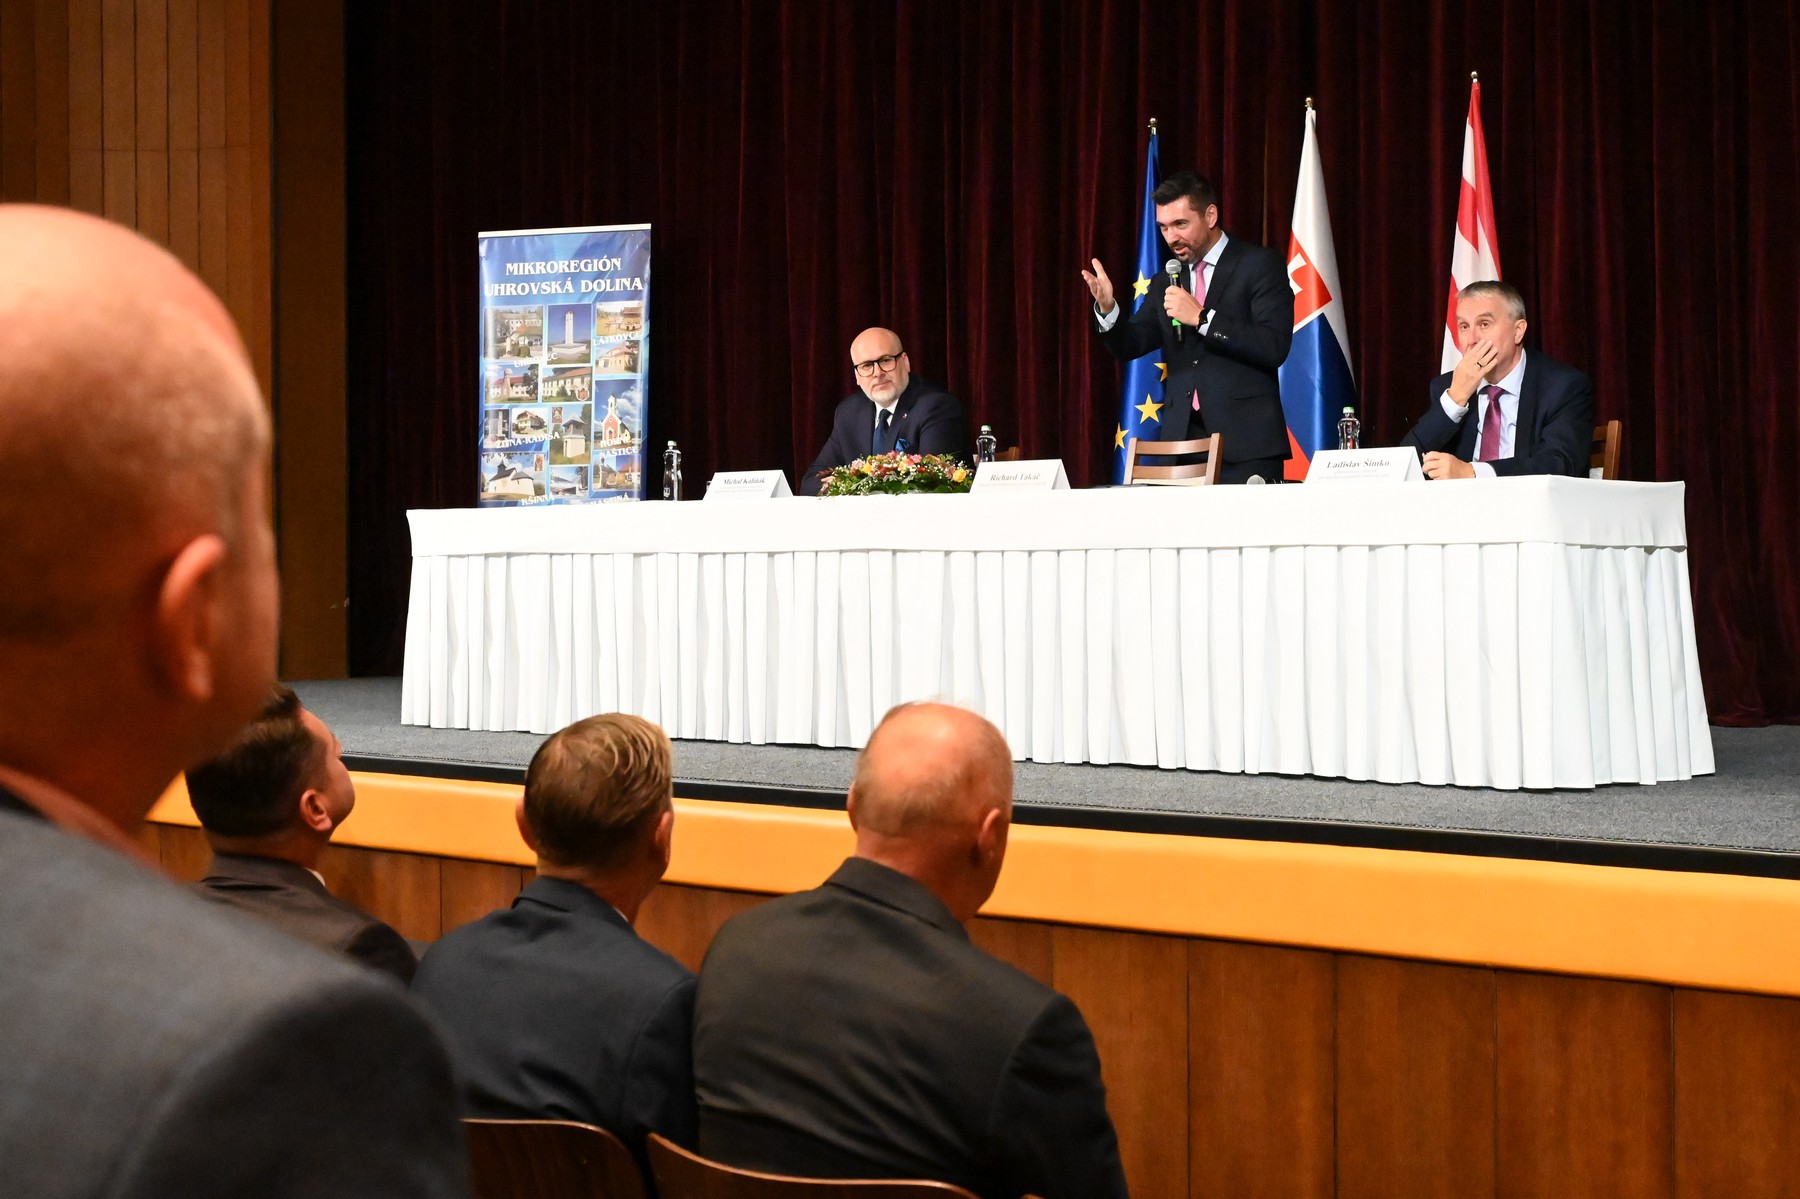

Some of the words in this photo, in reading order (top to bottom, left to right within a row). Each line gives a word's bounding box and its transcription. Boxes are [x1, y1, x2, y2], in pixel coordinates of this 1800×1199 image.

[505, 255, 622, 276] MIKROREGIÓN
[484, 277, 574, 297] UHROVSKÁ
[580, 277, 644, 293] DOLINA
[1326, 460, 1361, 469] Ladislav
[990, 473, 1018, 482] Richard
